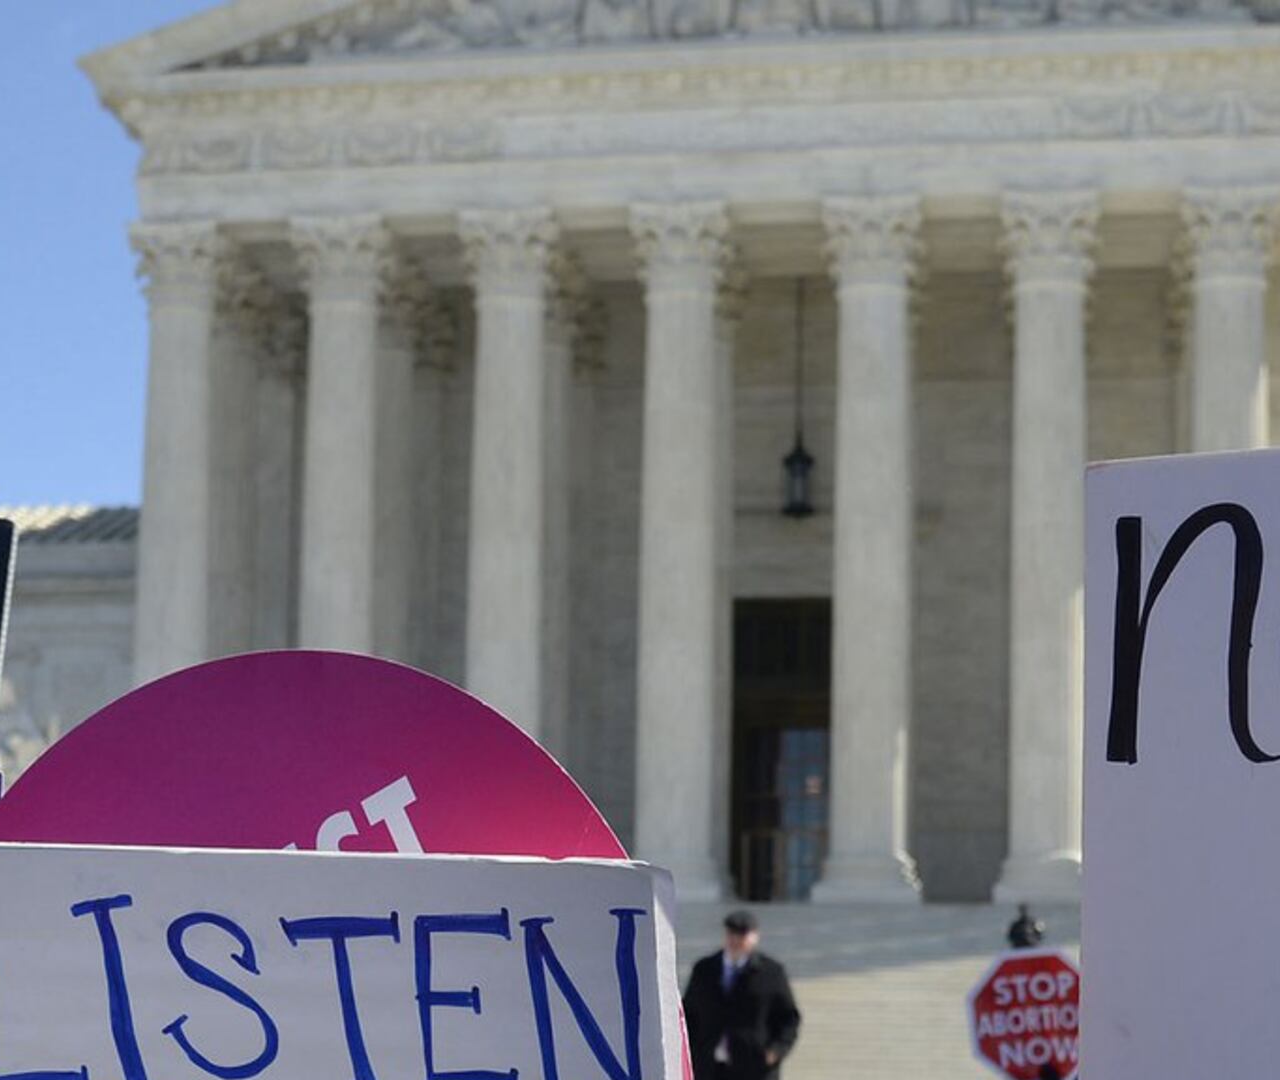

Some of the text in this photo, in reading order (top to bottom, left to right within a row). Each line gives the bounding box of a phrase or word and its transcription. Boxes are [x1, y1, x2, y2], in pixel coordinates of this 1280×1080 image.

[993, 972, 1074, 1006] STOP
[978, 1004, 1078, 1038] ABORTIO
[999, 1035, 1079, 1067] NOW
